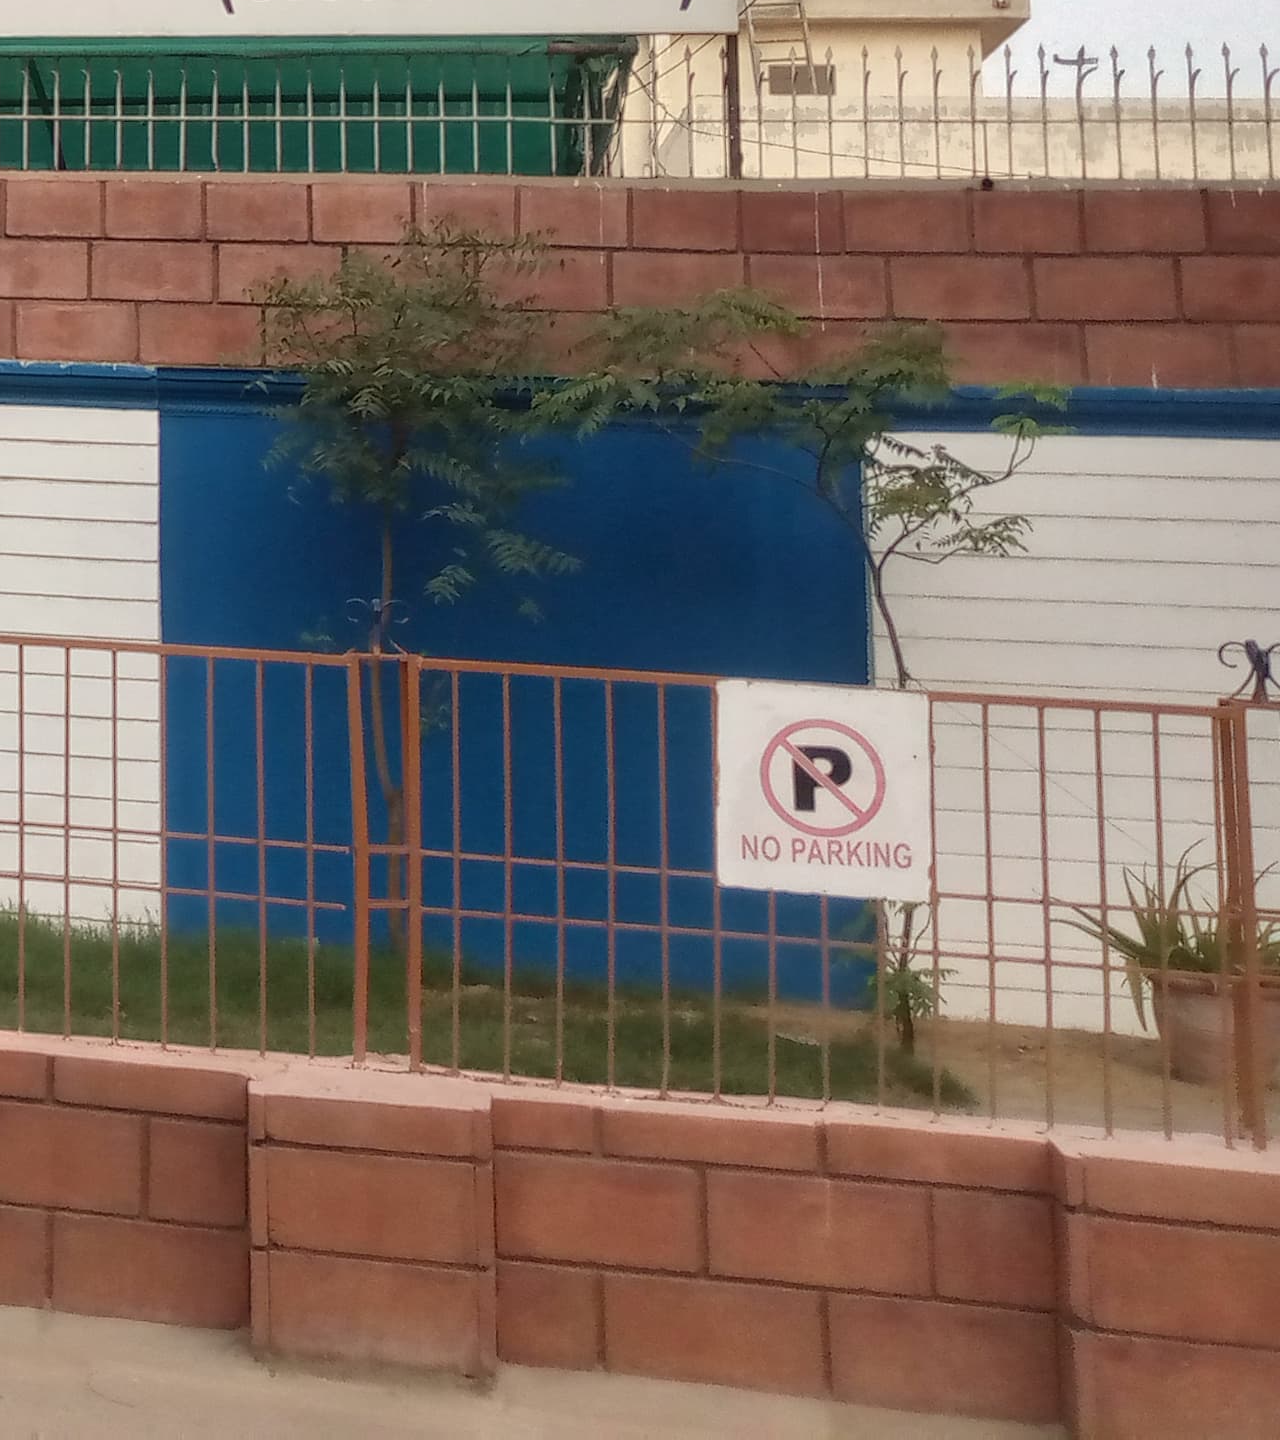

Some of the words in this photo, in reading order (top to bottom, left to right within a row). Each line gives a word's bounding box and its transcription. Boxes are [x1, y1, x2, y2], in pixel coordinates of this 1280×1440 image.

[793, 745, 852, 812] P
[741, 834, 781, 862] NO
[791, 838, 912, 869] PARKING
